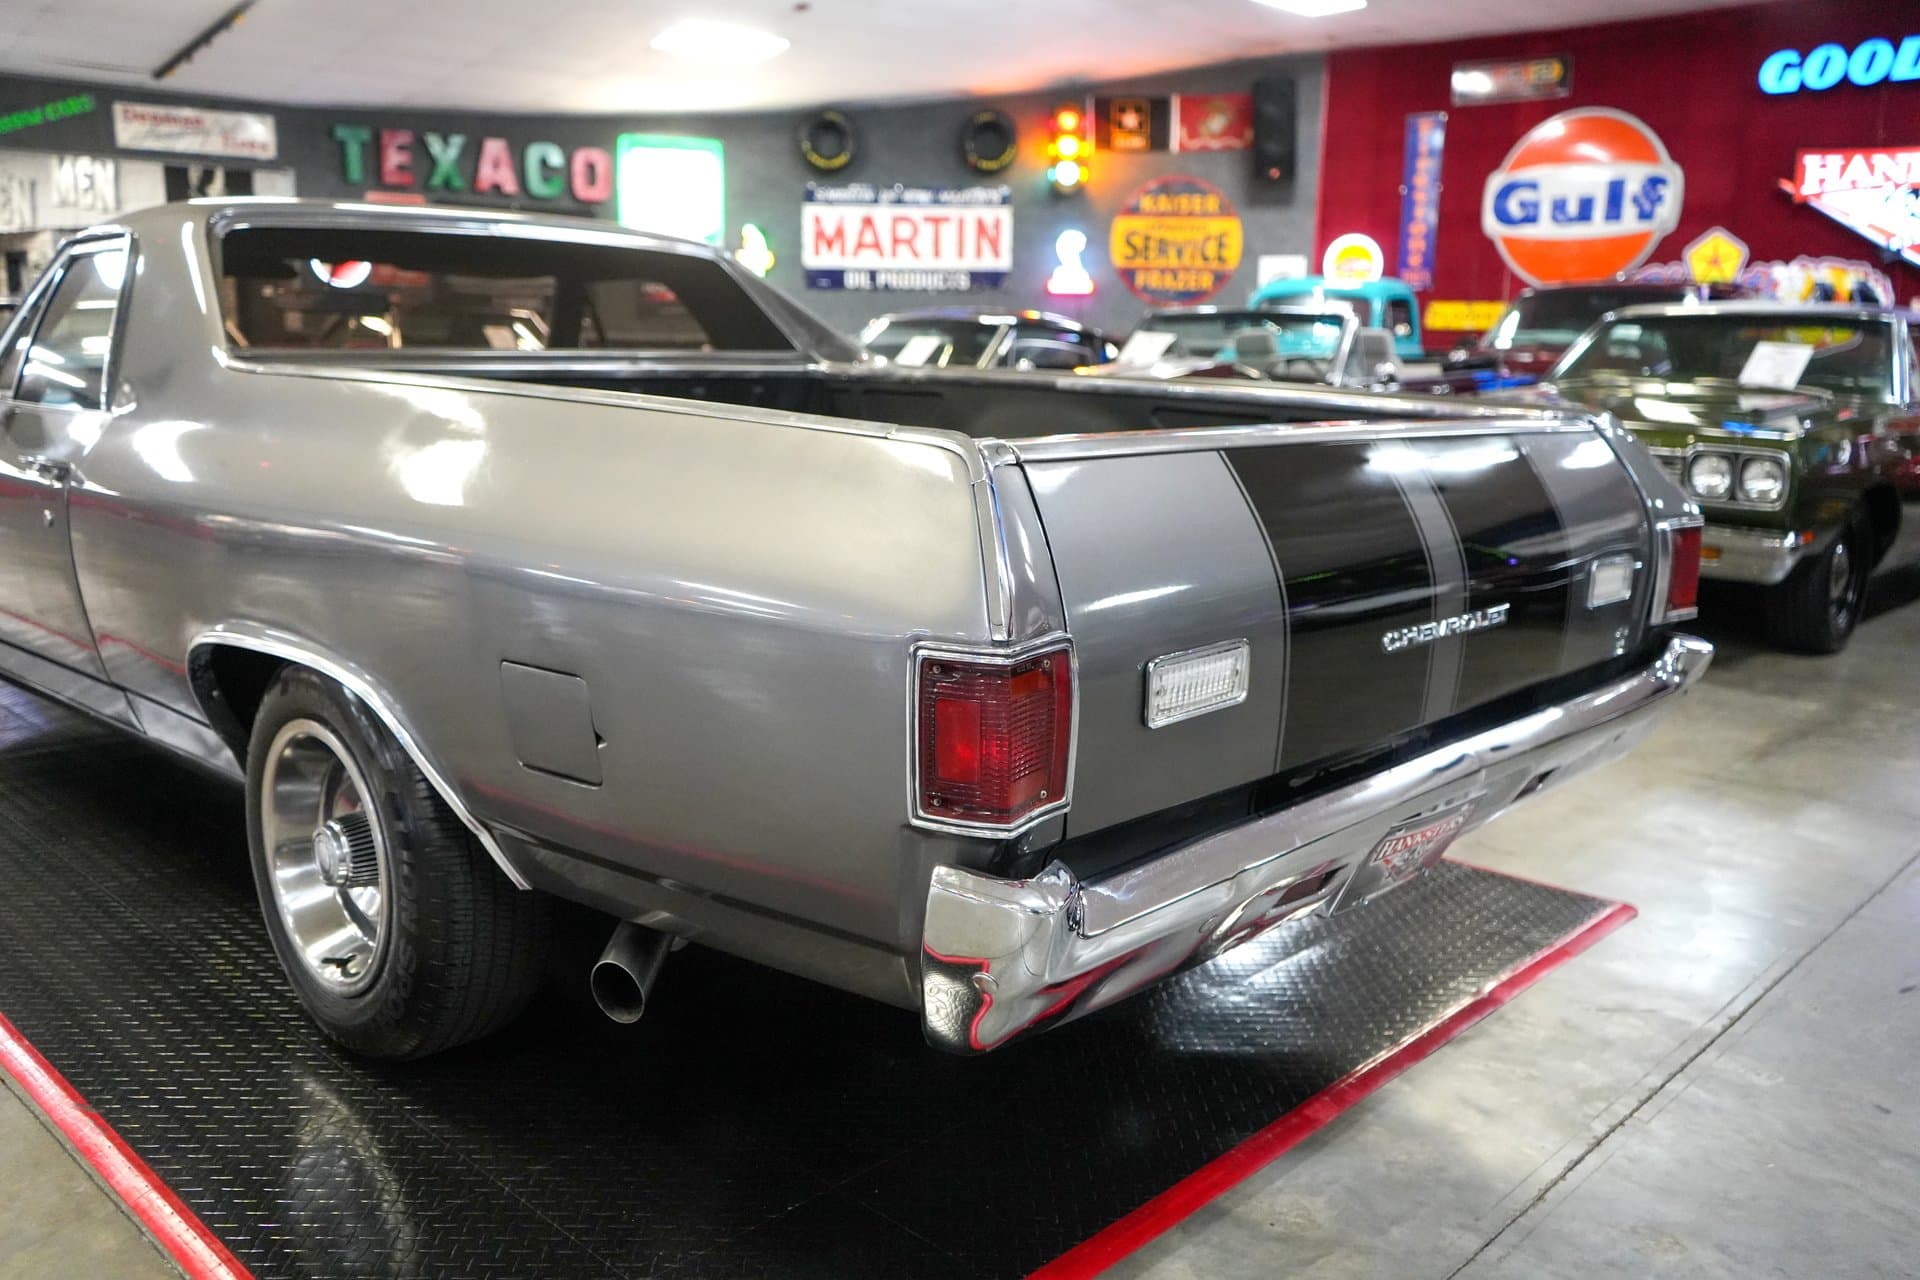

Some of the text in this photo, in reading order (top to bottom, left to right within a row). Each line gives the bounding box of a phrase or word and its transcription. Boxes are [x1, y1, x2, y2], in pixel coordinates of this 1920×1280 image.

[334, 123, 612, 203] TEXACO
[1493, 175, 1669, 225] Gulf
[813, 214, 1002, 260] MARTIN
[1124, 229, 1228, 264] SERVICE
[1382, 602, 1511, 652] CHEVROLET
